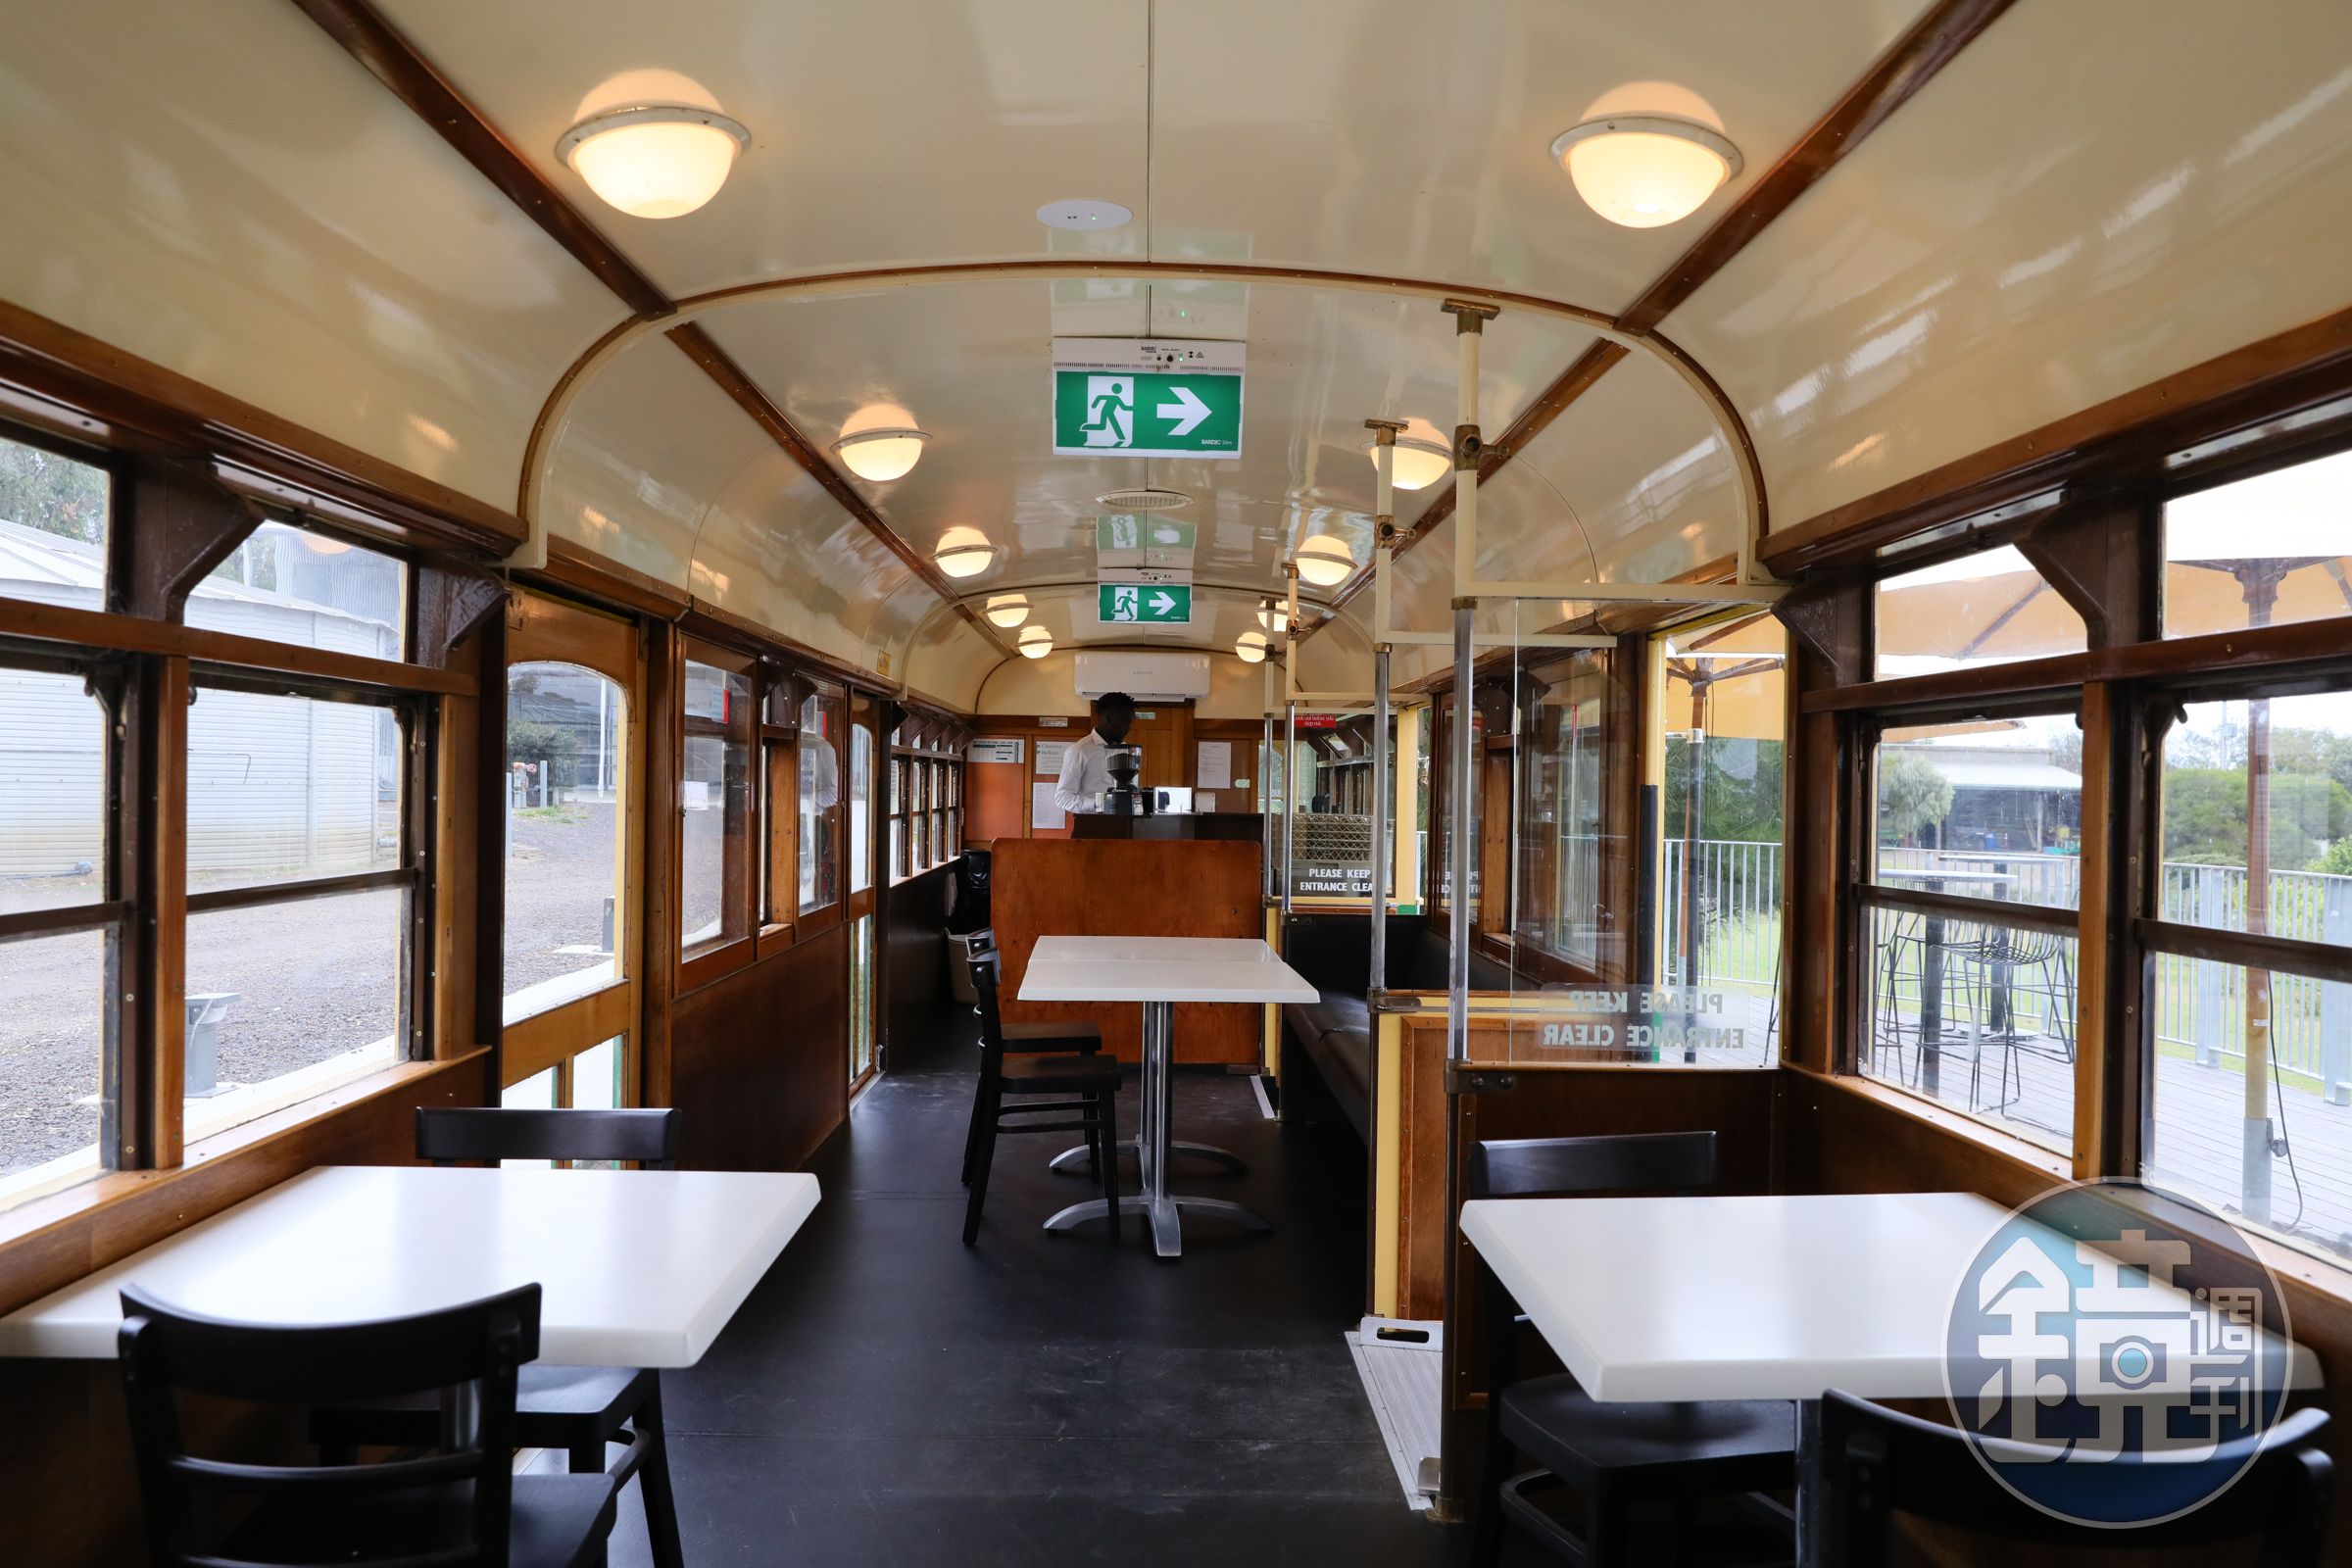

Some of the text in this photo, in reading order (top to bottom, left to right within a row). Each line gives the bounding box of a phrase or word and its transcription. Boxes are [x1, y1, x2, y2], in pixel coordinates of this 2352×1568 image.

[1308, 868, 1371, 879] PLEASE KEEP
[1299, 881, 1373, 892] ENTRANCE CLEA
